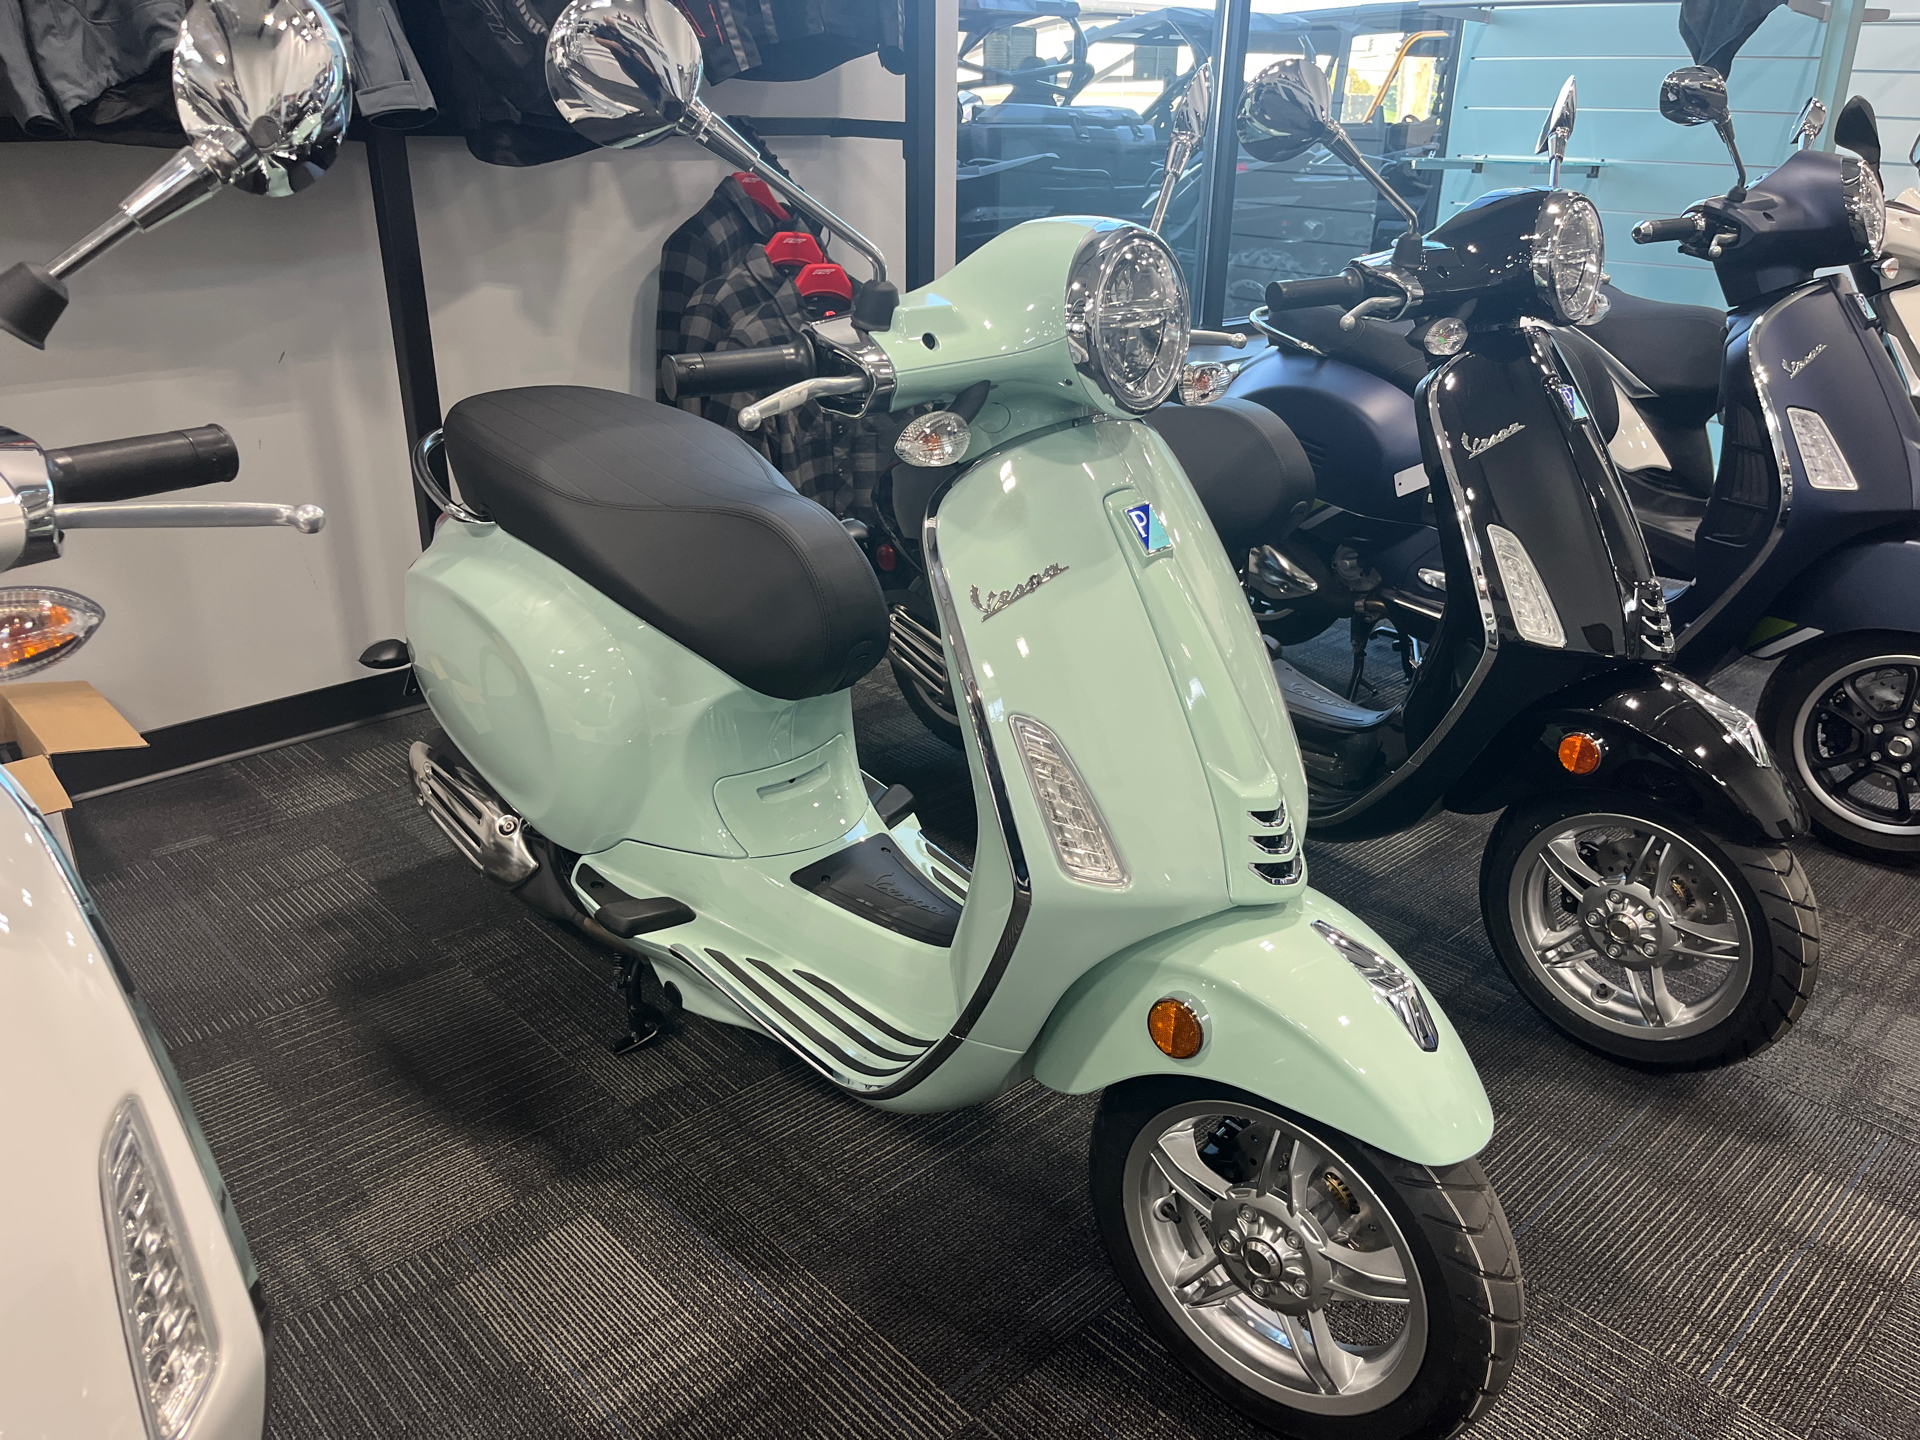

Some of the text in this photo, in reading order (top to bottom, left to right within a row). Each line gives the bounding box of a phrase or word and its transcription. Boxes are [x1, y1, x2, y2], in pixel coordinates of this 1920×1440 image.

[1781, 343, 1828, 379] Vespa
[1562, 389, 1574, 409] P
[1461, 421, 1526, 460] Vespa
[1128, 510, 1148, 538] P
[969, 562, 1070, 623] Vespa
[864, 871, 947, 917] Vespa
